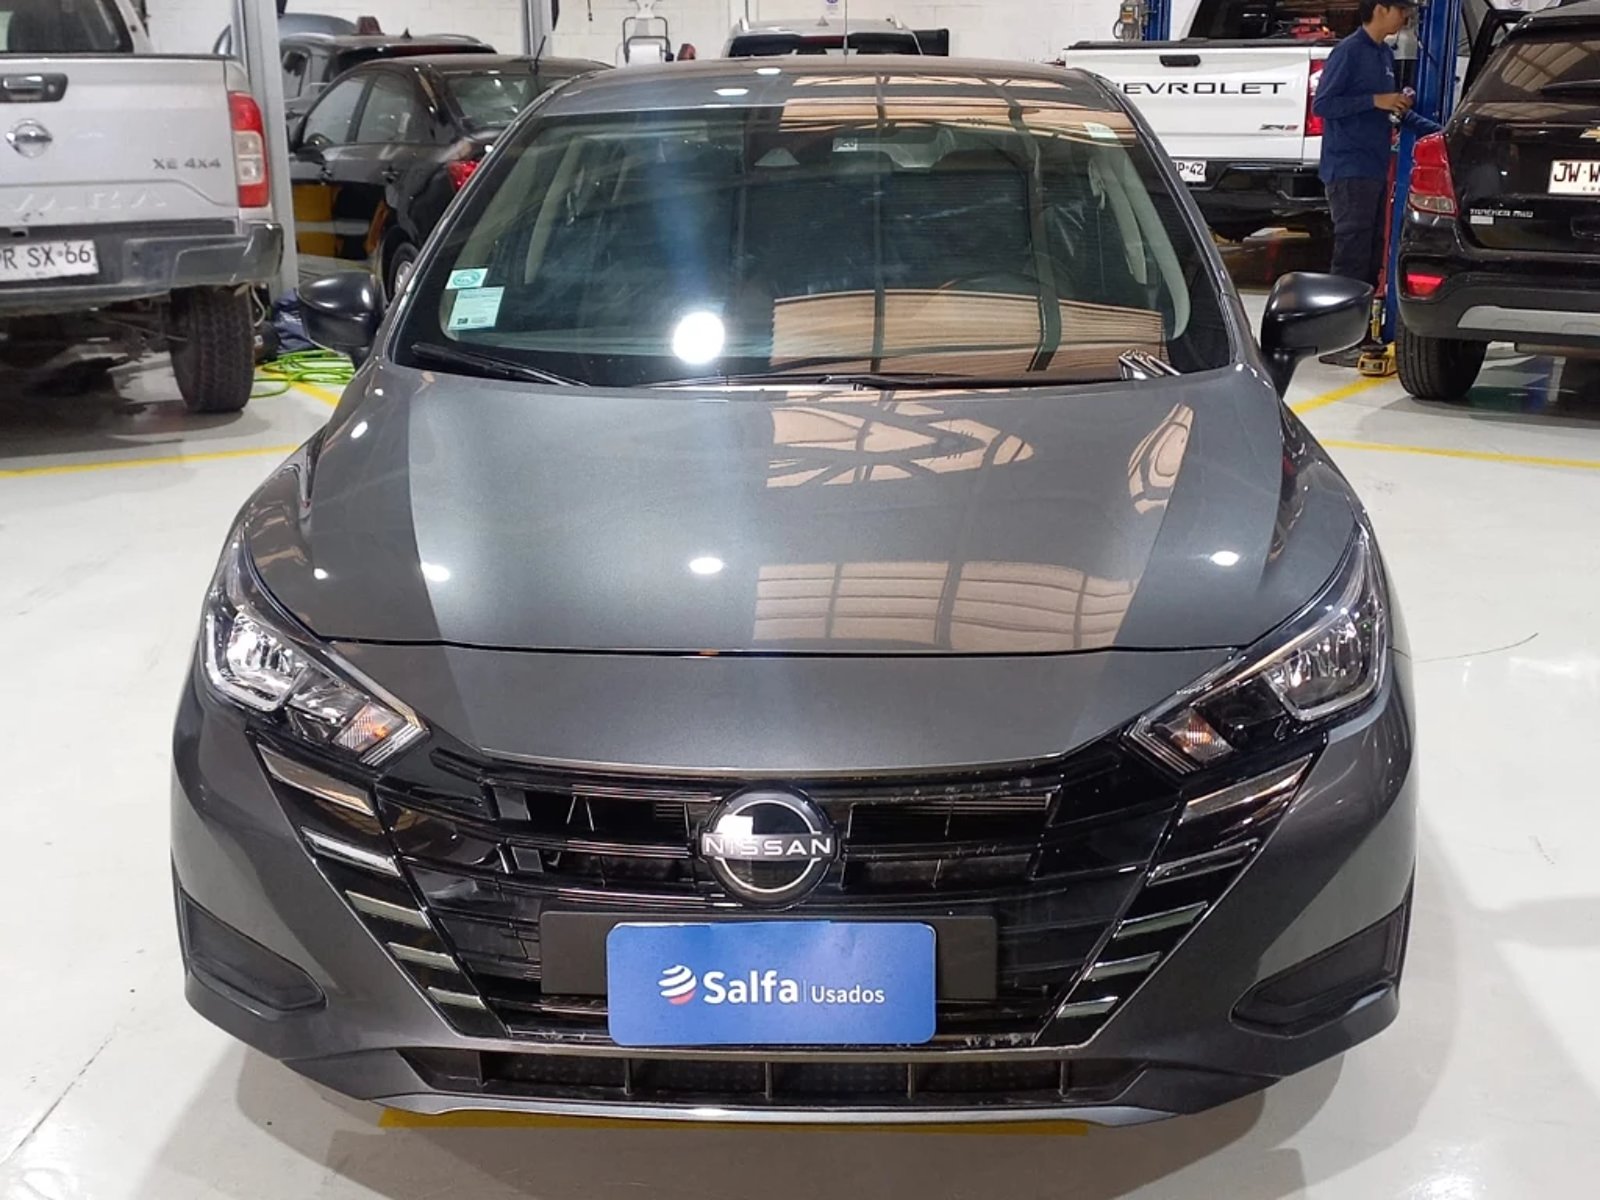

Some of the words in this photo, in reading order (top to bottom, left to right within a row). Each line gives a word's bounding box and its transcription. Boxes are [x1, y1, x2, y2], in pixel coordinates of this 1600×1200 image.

[1115, 82, 1287, 95] EVROLET
[705, 837, 831, 856] NISSAN
[703, 969, 798, 1004] Salfa
[811, 985, 885, 1004] Usados
